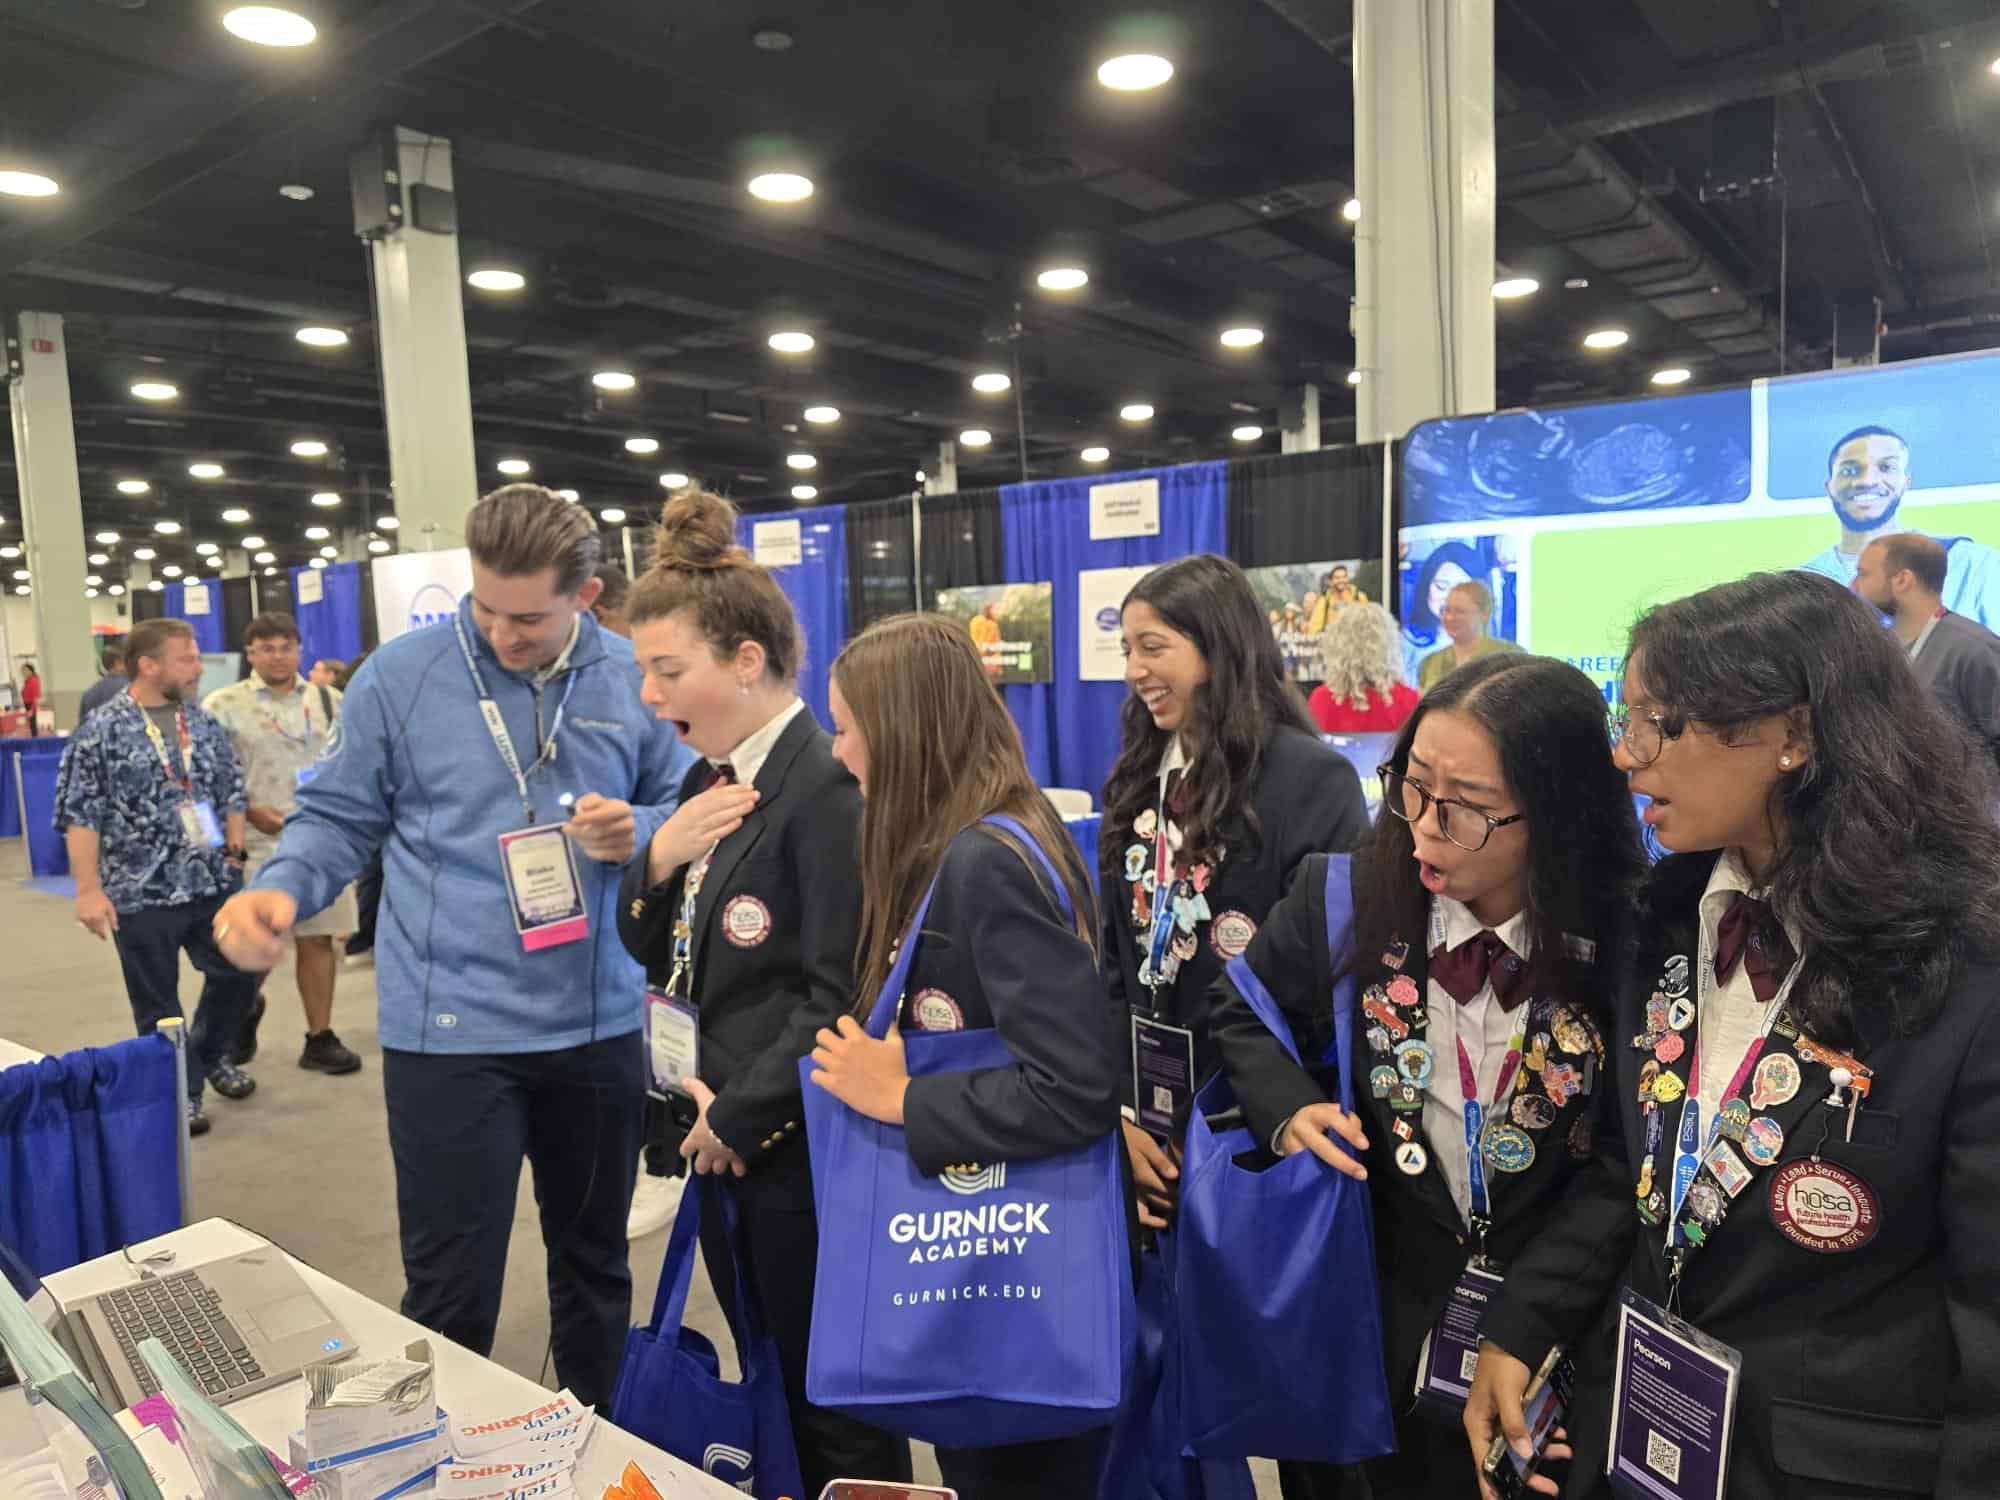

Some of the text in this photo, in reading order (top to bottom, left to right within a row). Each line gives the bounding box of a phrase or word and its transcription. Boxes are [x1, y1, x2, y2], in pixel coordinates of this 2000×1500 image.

[1784, 1164, 1808, 1182] Lead
[1815, 1164, 1847, 1182] Serve
[1794, 1183, 1853, 1213] hosa
[888, 1202, 1051, 1243] GURNICK
[908, 1237, 1027, 1264] ACADEMY
[893, 1284, 1041, 1306] GURNICK.EDU
[1633, 1337, 1672, 1372] Pearson
[461, 1398, 568, 1437] HEARING
[522, 1405, 572, 1431] Help
